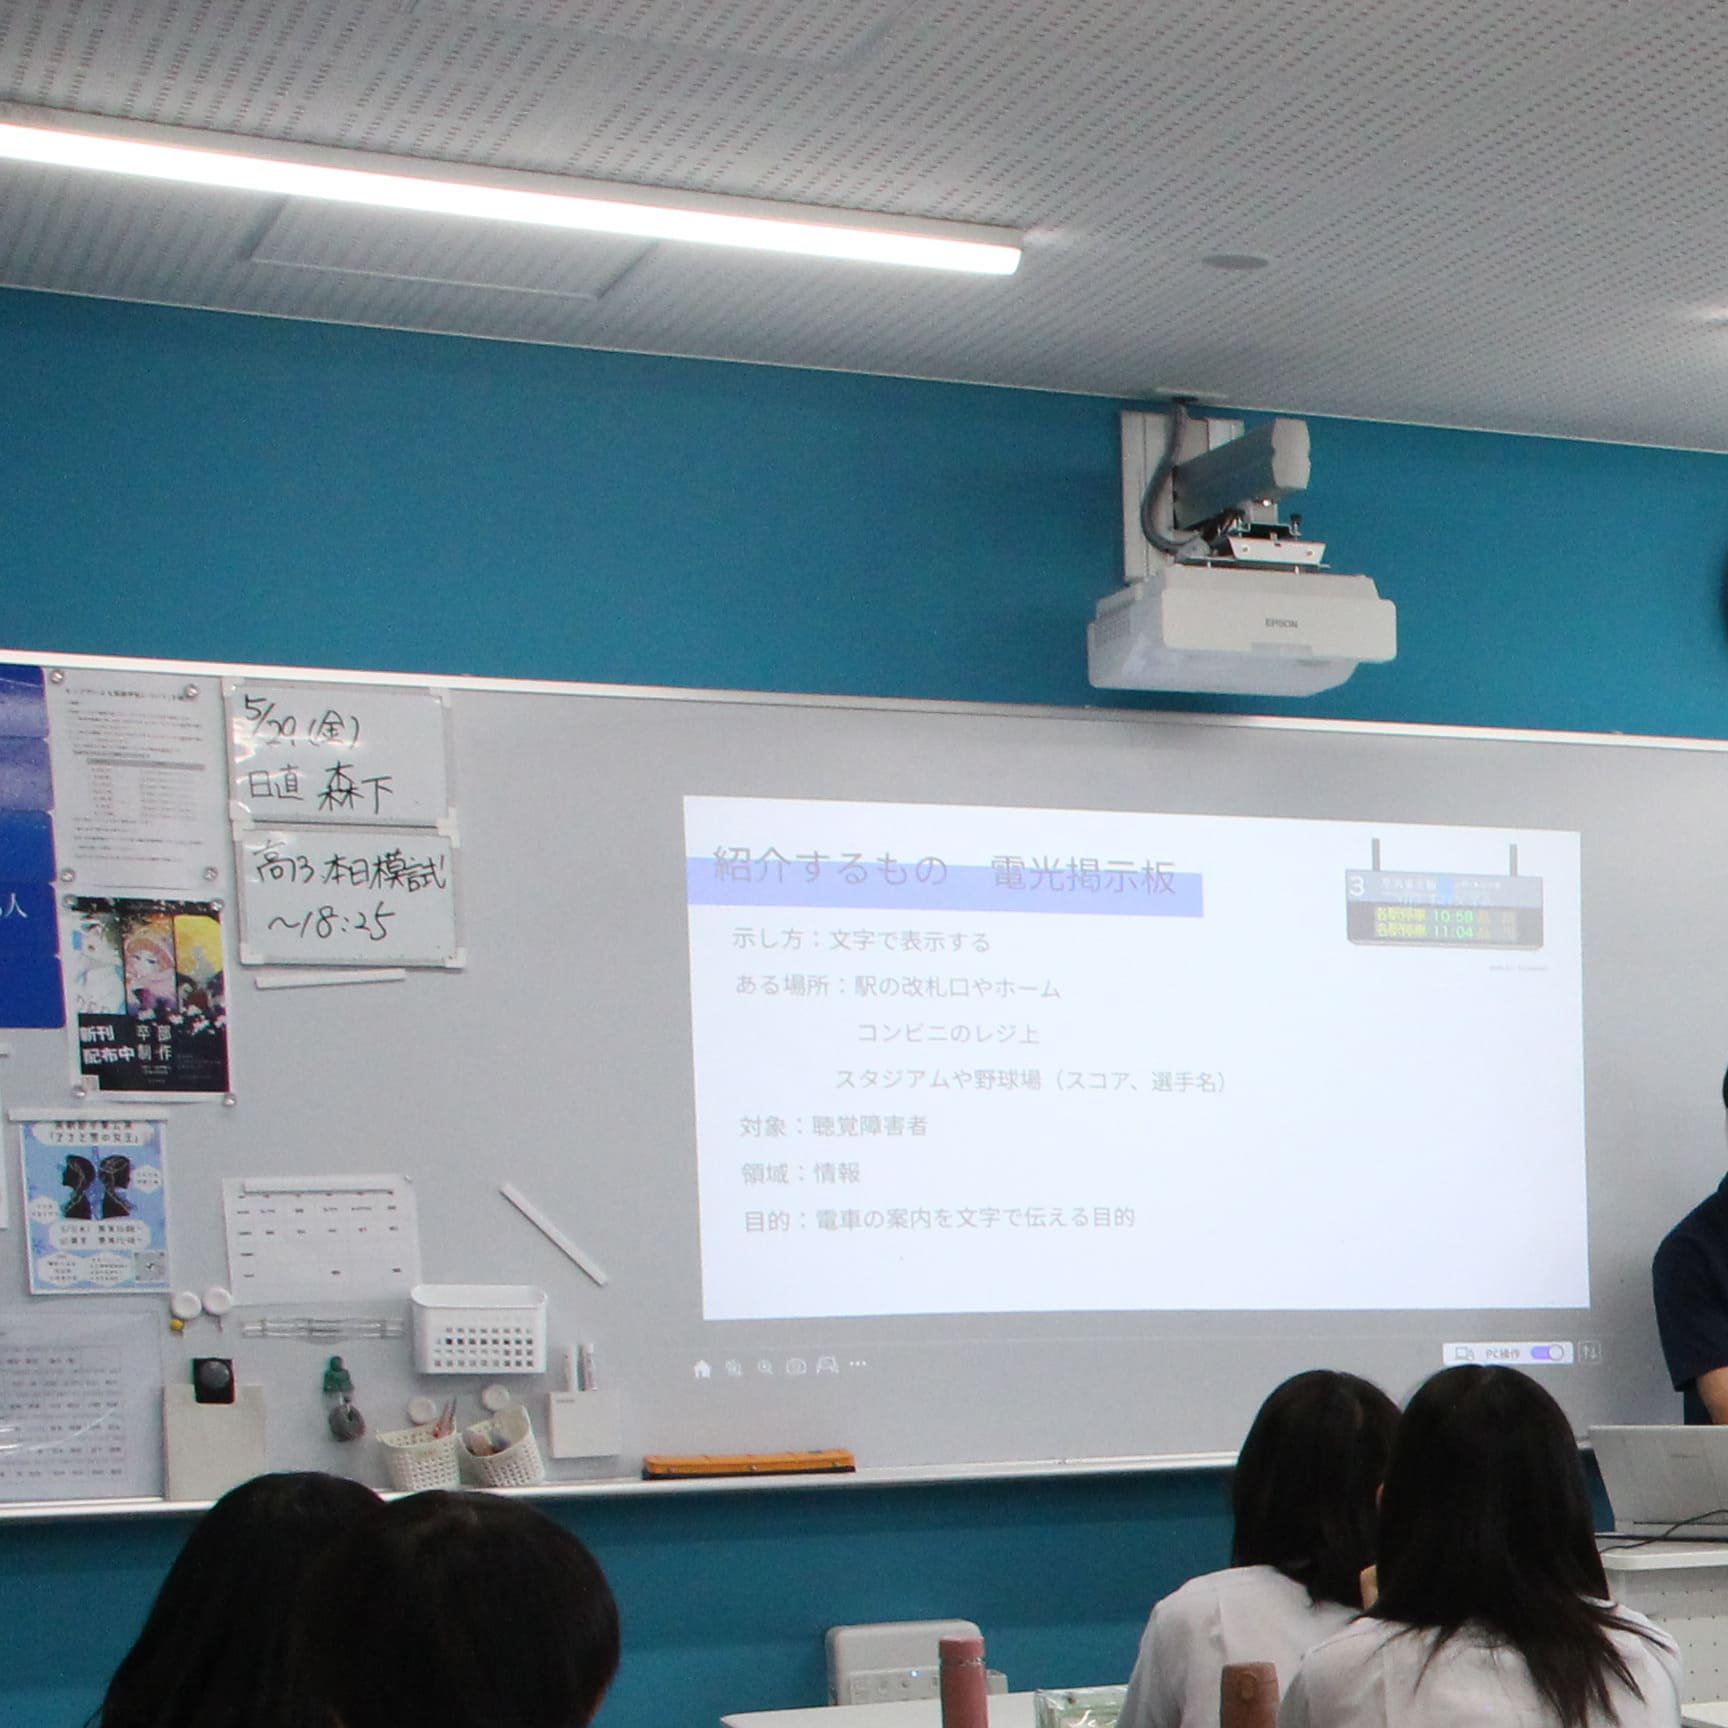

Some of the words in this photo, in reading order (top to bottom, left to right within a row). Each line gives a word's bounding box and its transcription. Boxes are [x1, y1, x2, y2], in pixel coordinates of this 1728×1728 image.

[1265, 618, 1298, 628] EPSON
[249, 763, 304, 801] 日直
[713, 846, 948, 886] 紹介するもの
[991, 855, 1177, 896] 電光掲示板
[1350, 876, 1364, 896] 3
[732, 927, 991, 953] 示し方：文字で表示する
[735, 974, 1061, 999] ある場所：駅の改札口やホーム
[858, 1023, 1041, 1045] コンビニのレジ上
[739, 1114, 928, 1138] 対象：聴覚障害者
[741, 1162, 861, 1185] 領域：情報
[744, 1206, 1136, 1233] 目的：電車の案内を文字で伝える目的
